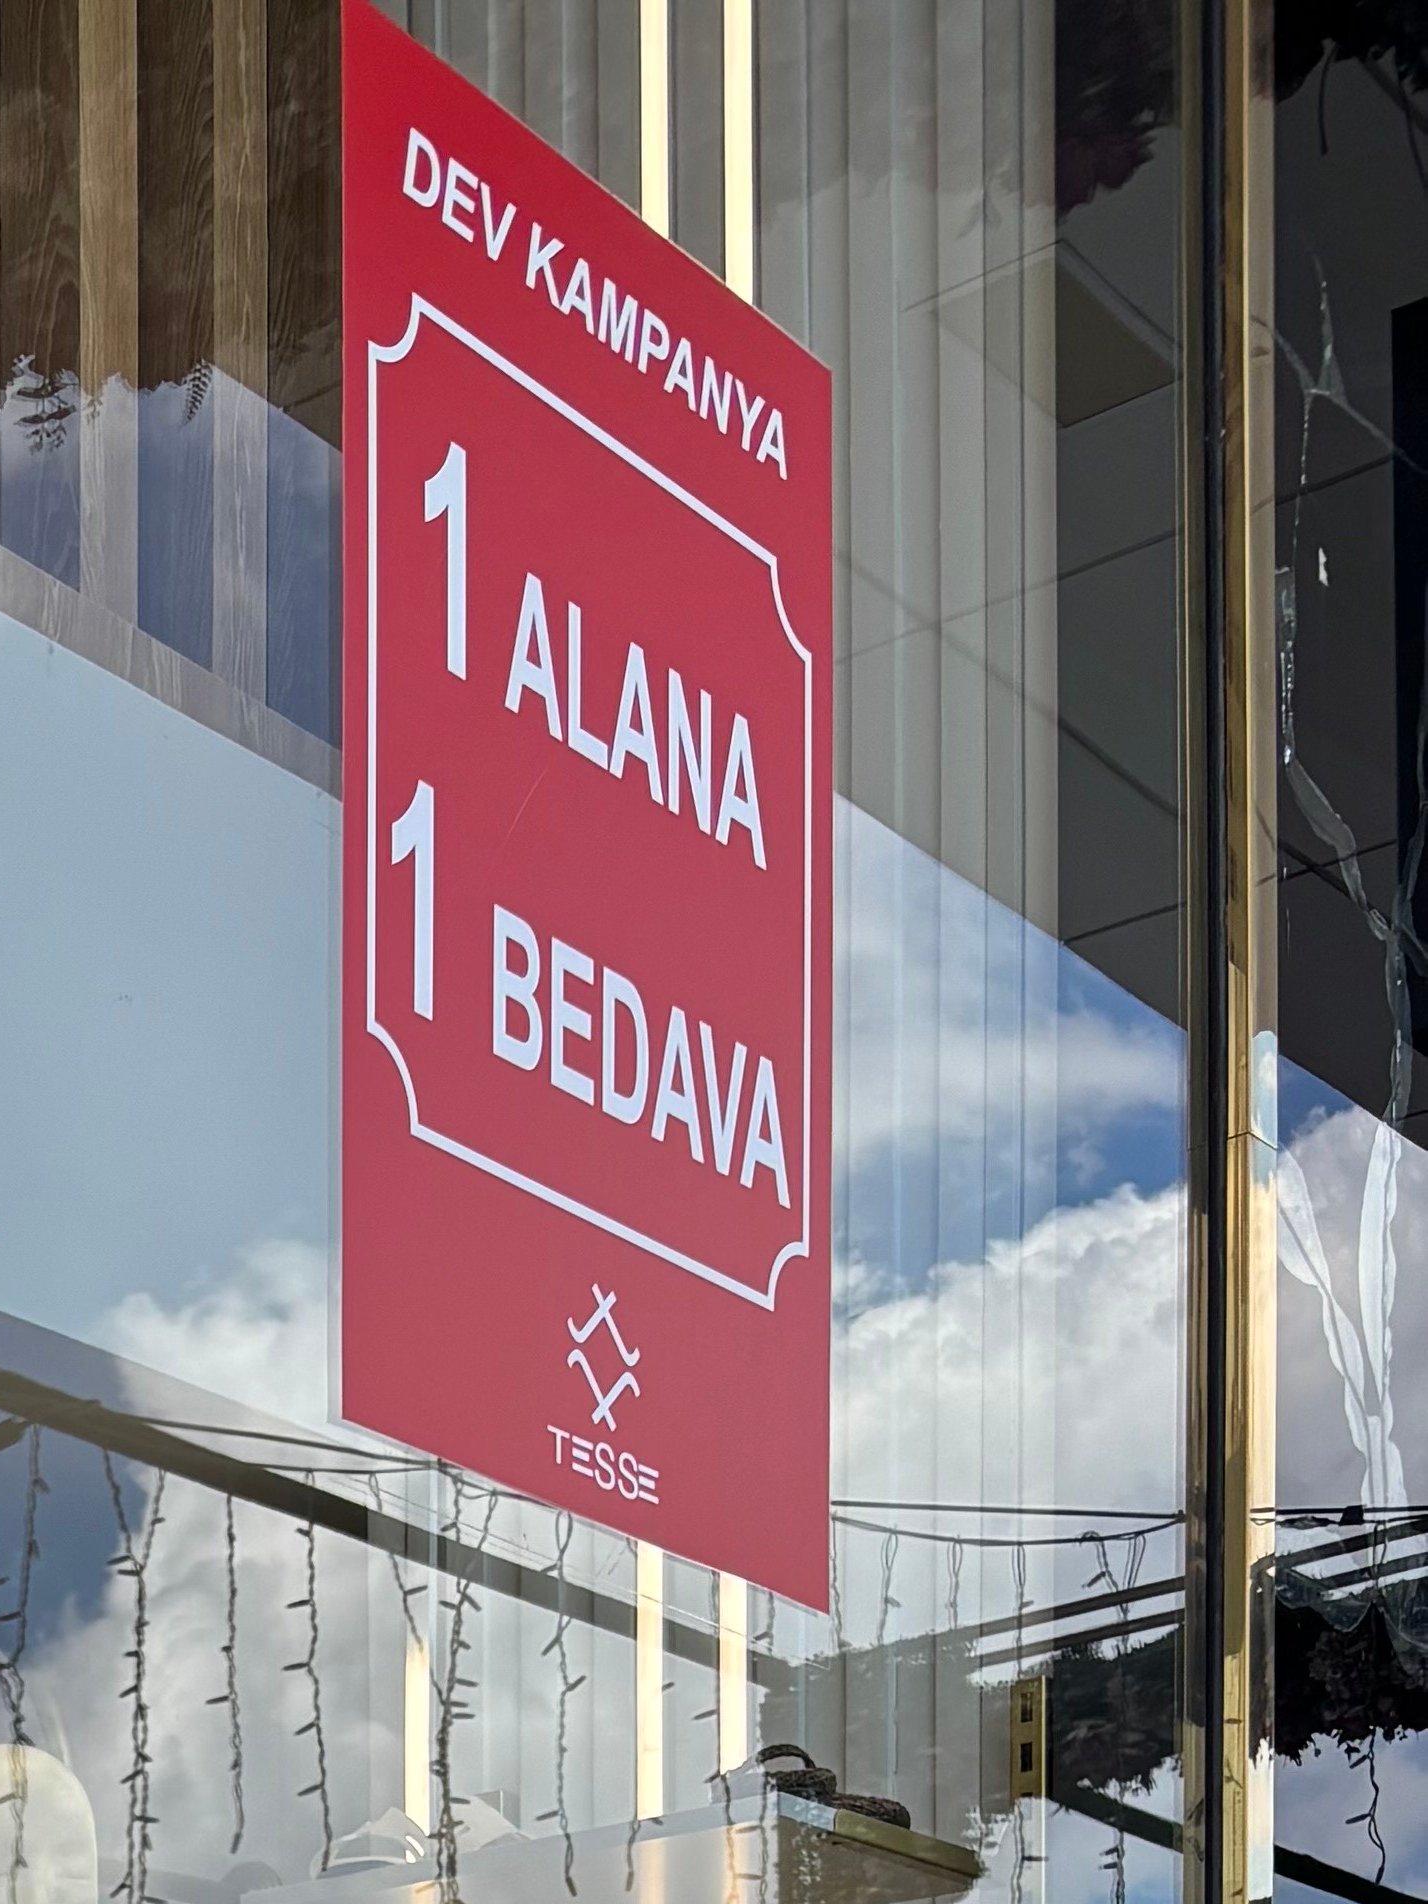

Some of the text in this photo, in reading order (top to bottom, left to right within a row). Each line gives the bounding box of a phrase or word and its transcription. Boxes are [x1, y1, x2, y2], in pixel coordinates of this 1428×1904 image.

[402, 126, 788, 482] DEV KAMPANYA
[424, 441, 767, 871] 1 ALANA
[391, 779, 791, 1210] 1 BEDAVA
[546, 1424, 660, 1505] TESSE
